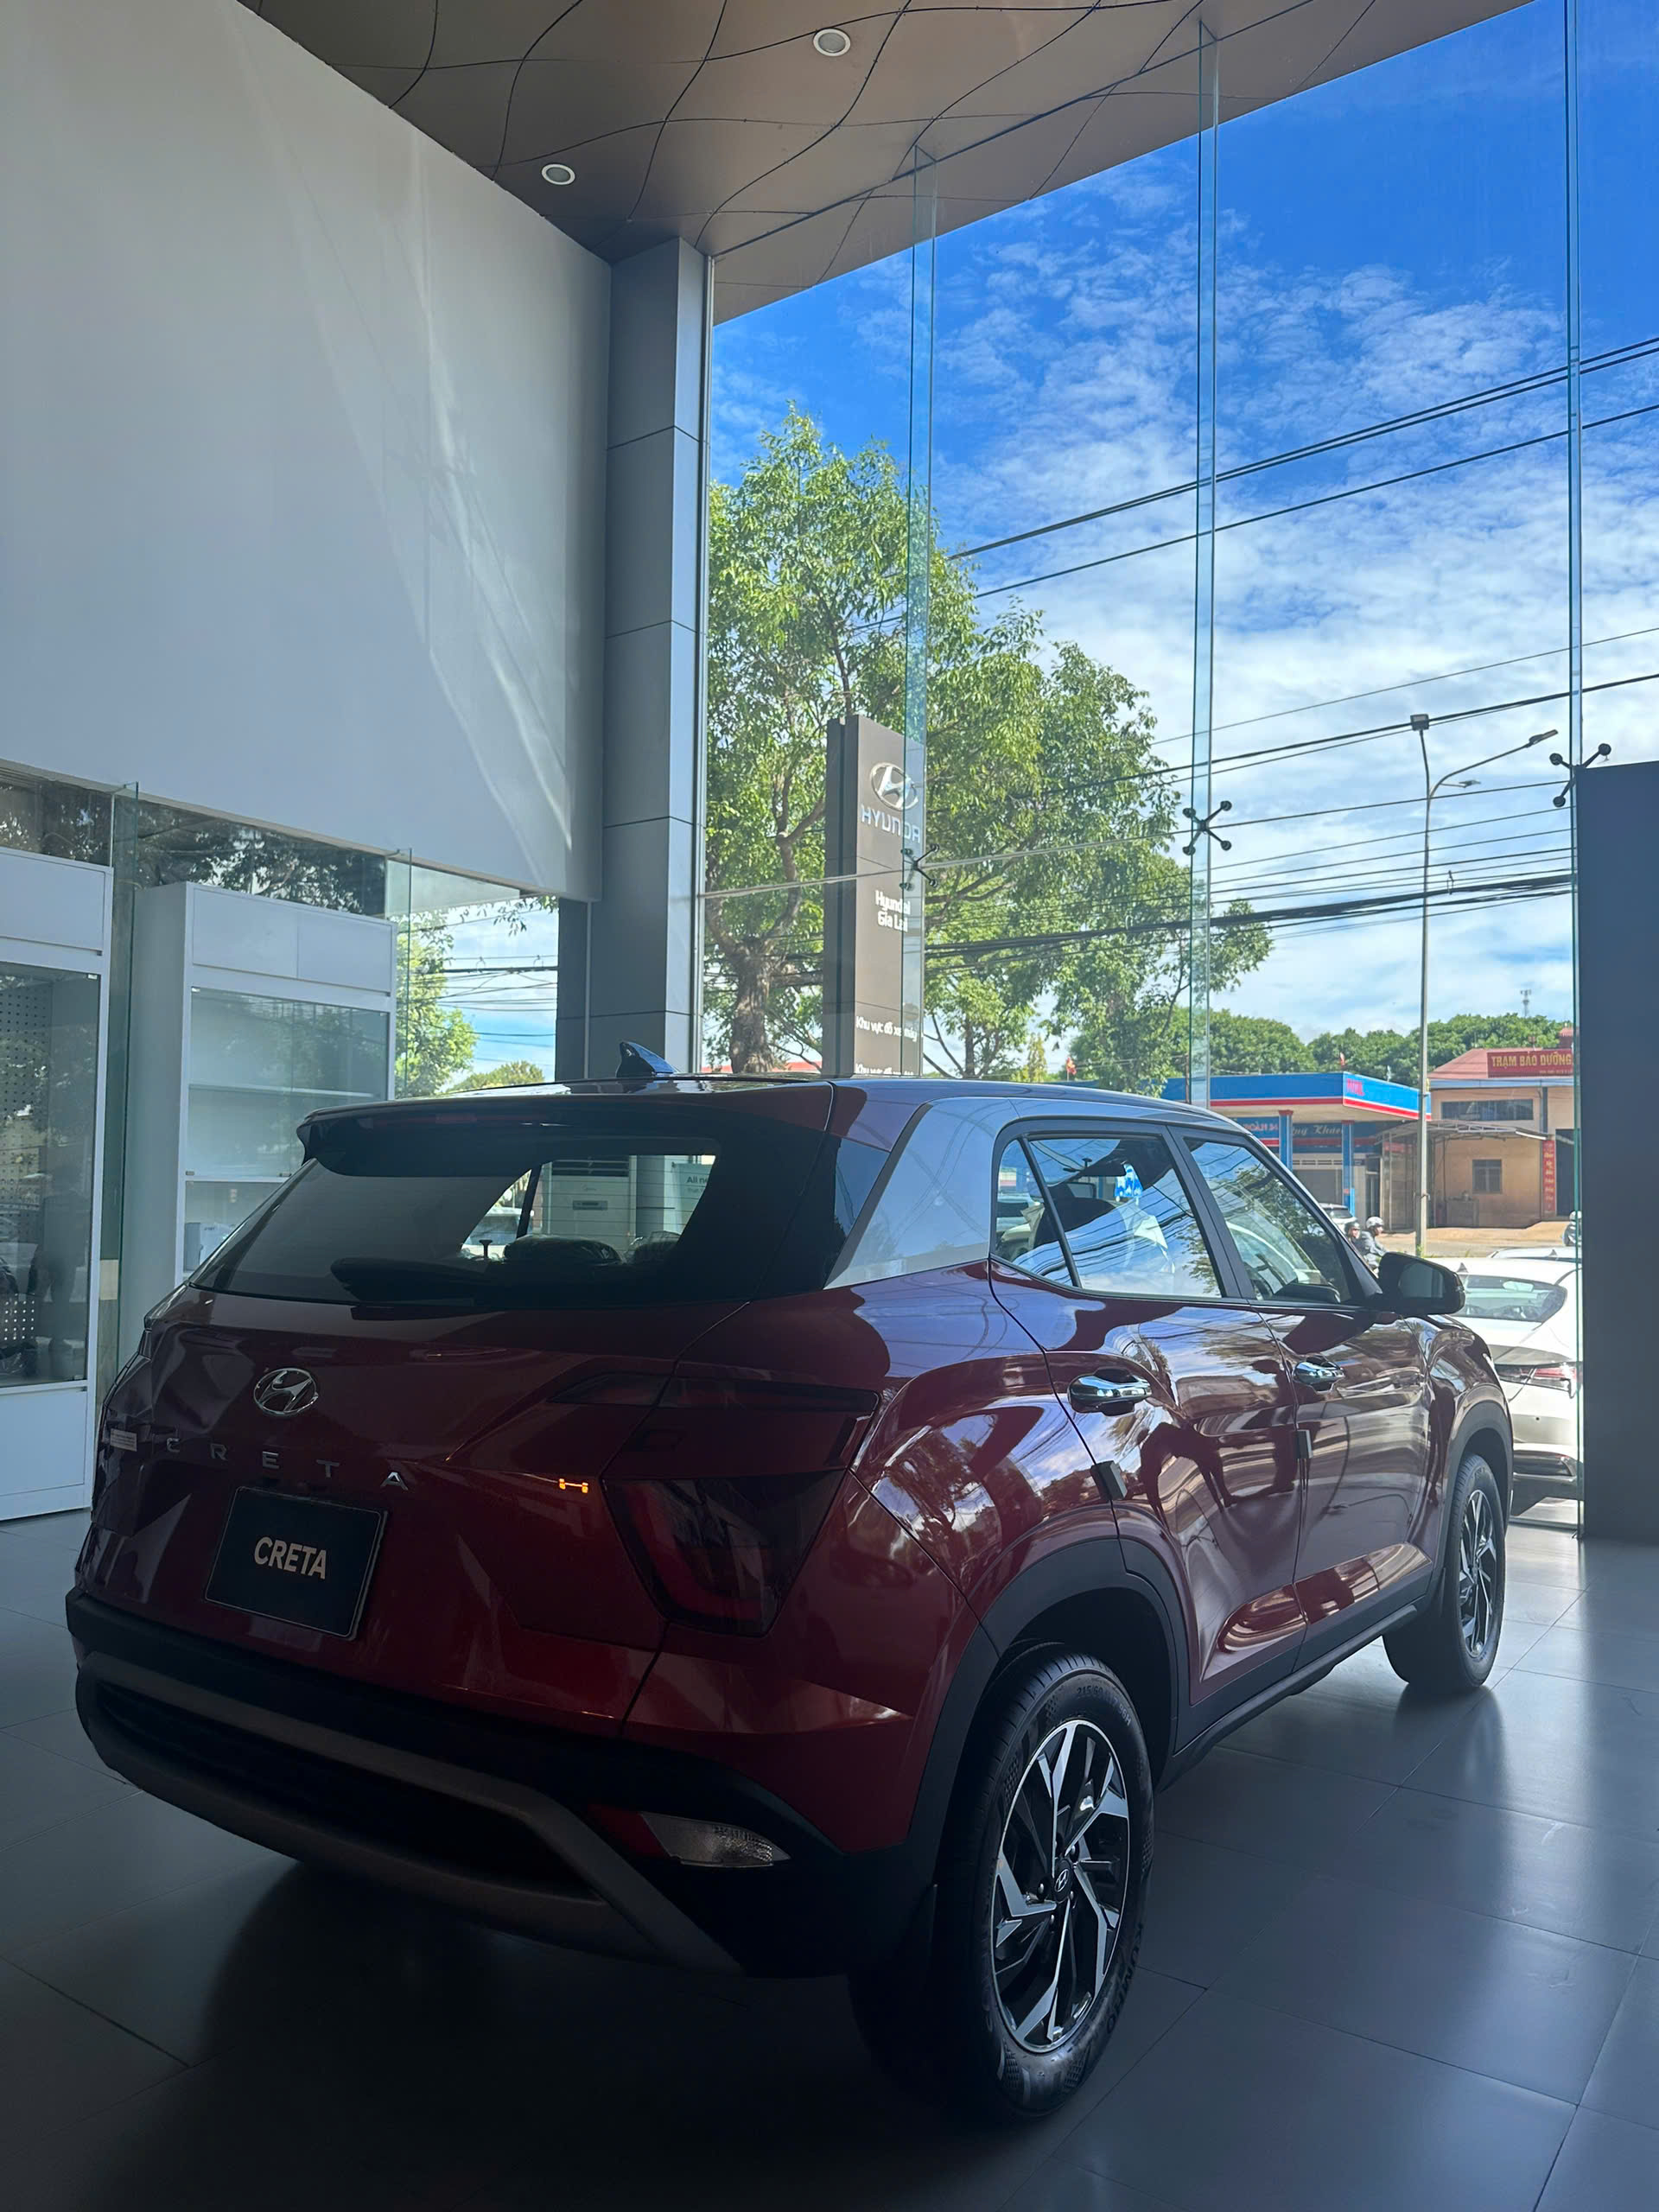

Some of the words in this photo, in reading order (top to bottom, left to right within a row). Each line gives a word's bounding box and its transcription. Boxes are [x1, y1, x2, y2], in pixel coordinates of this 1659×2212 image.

[861, 805, 921, 843] HYUNDA
[875, 890, 911, 915] Hyundai
[877, 911, 893, 928] Gia
[855, 1015, 870, 1030] Khu
[871, 1021, 884, 1035] vực
[1491, 1055, 1516, 1070] TRẠM
[167, 1437, 409, 1491] CRETA
[253, 1535, 327, 1580] CRETA
